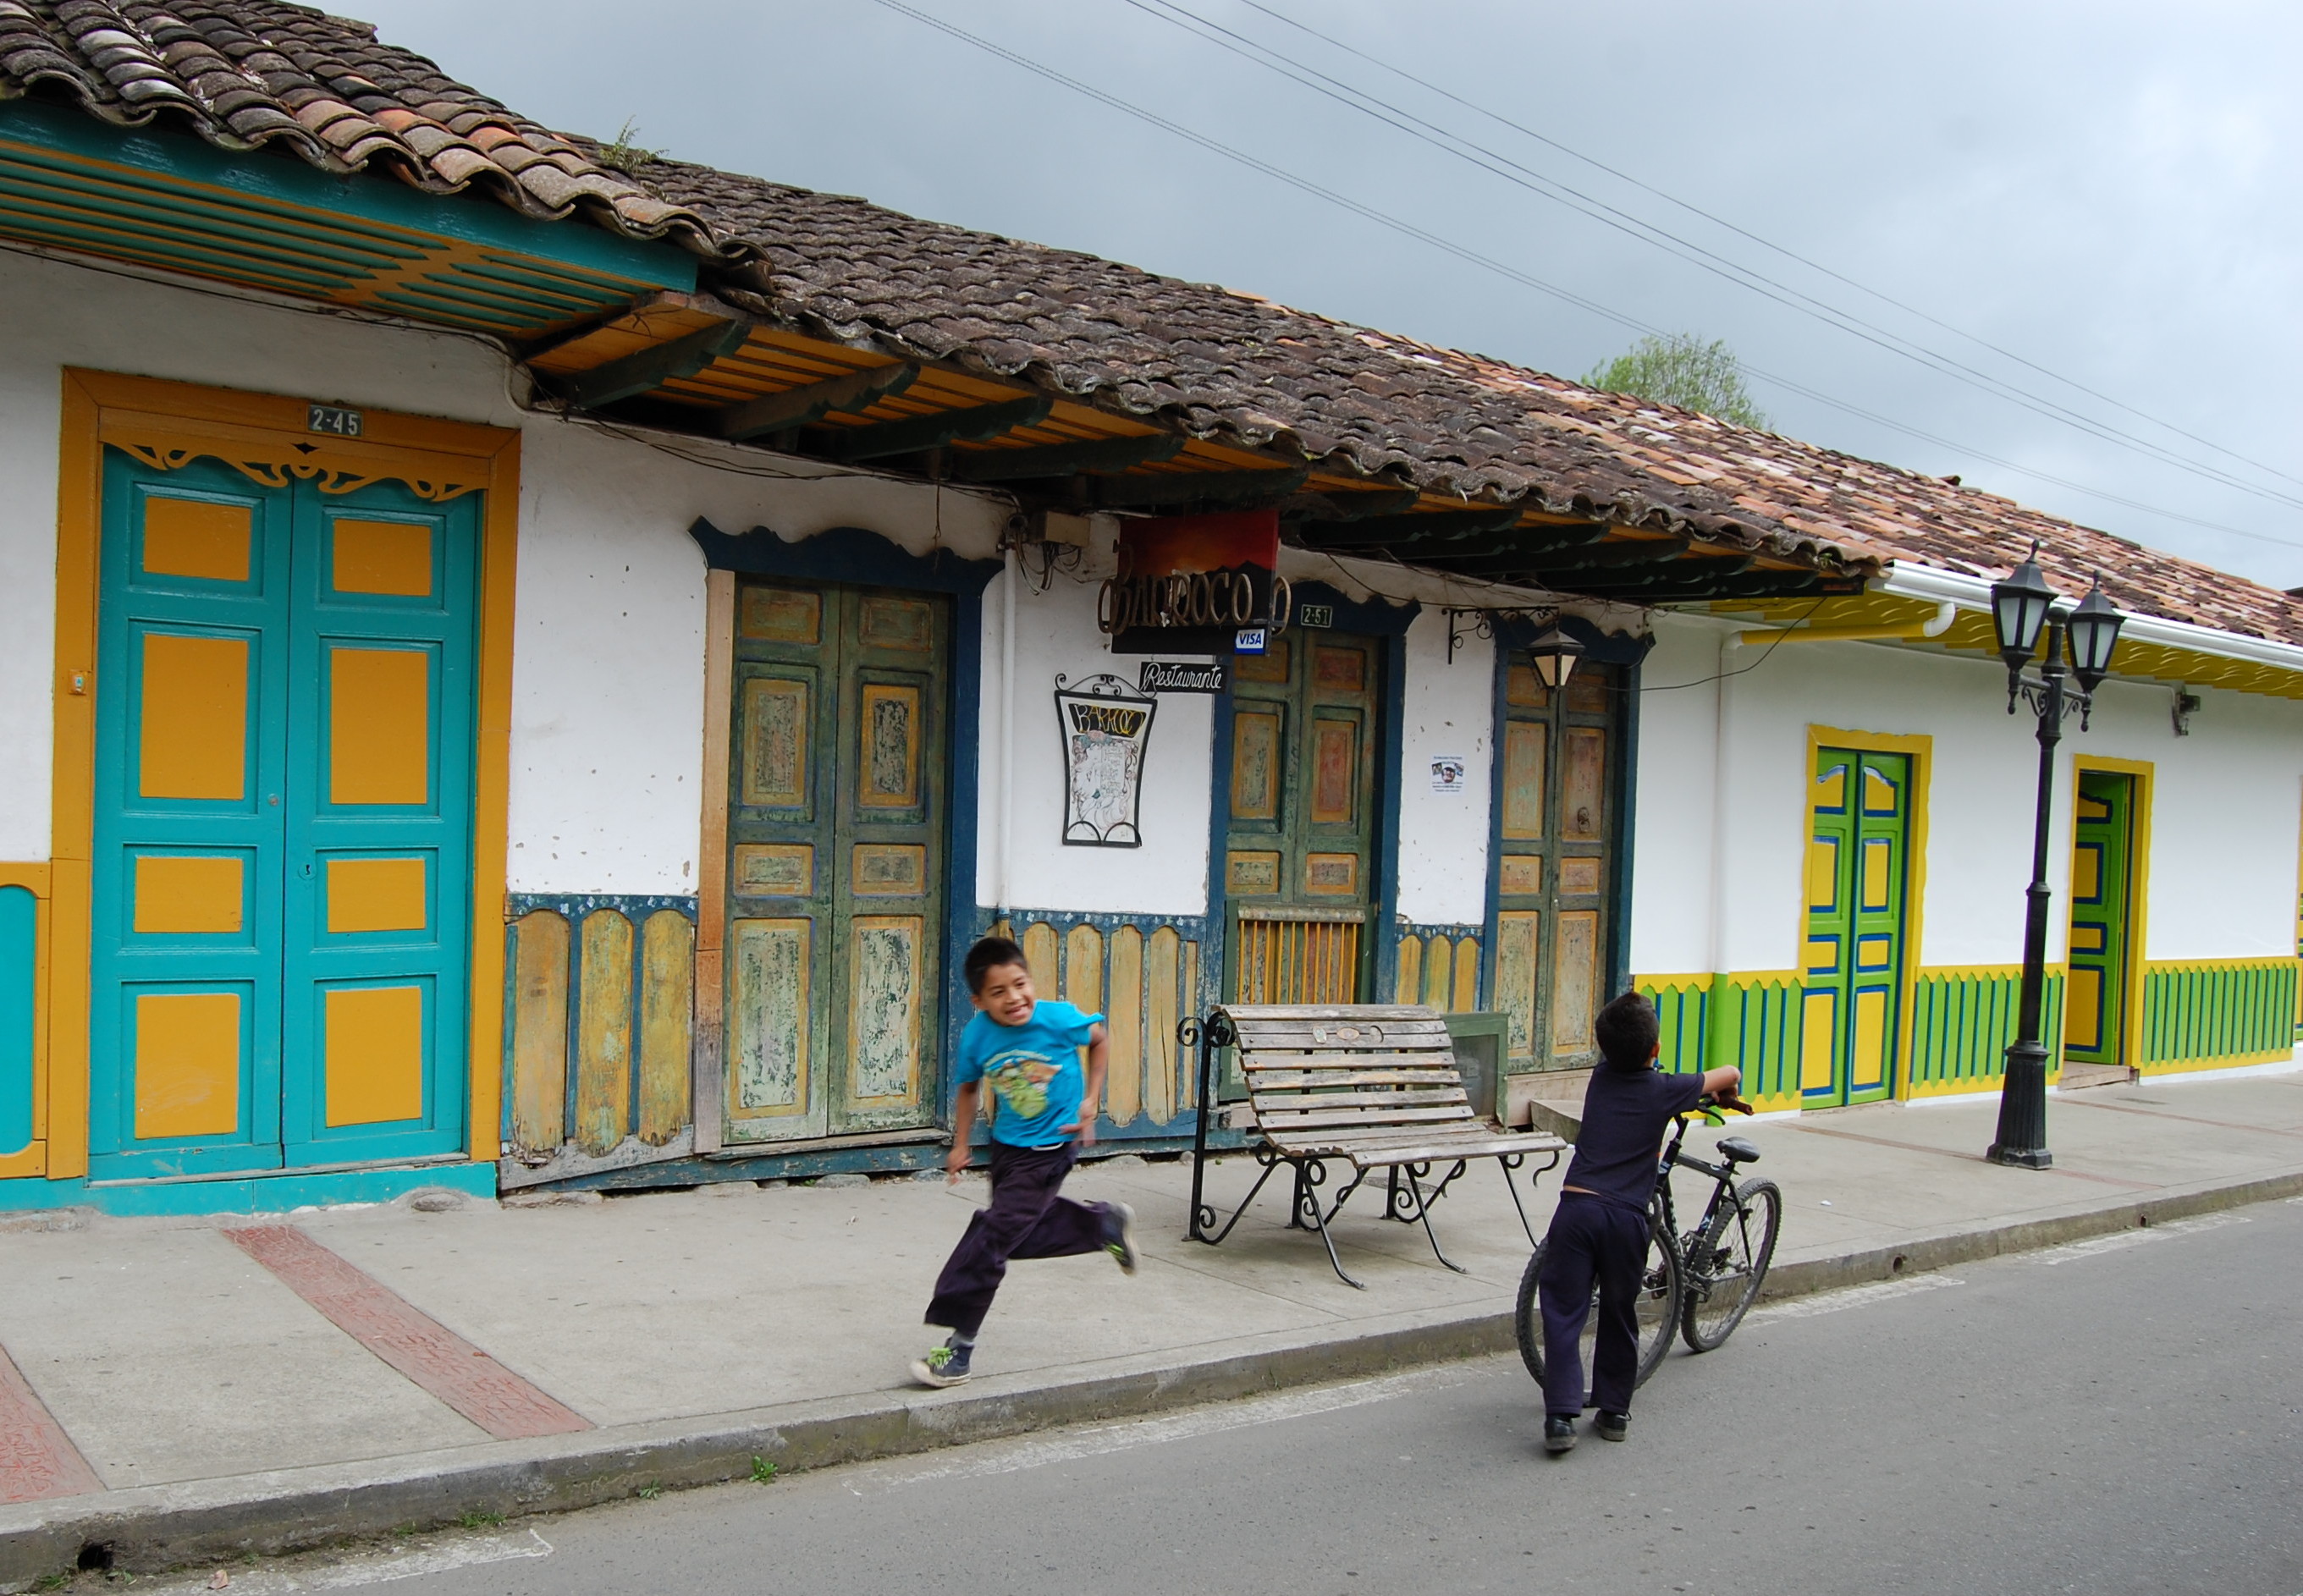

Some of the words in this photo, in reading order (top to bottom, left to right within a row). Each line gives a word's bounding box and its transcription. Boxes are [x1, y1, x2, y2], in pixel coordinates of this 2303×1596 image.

[312, 408, 359, 435] 2-45
[1238, 632, 1262, 645] VISA
[1143, 663, 1222, 691] Restaurante
